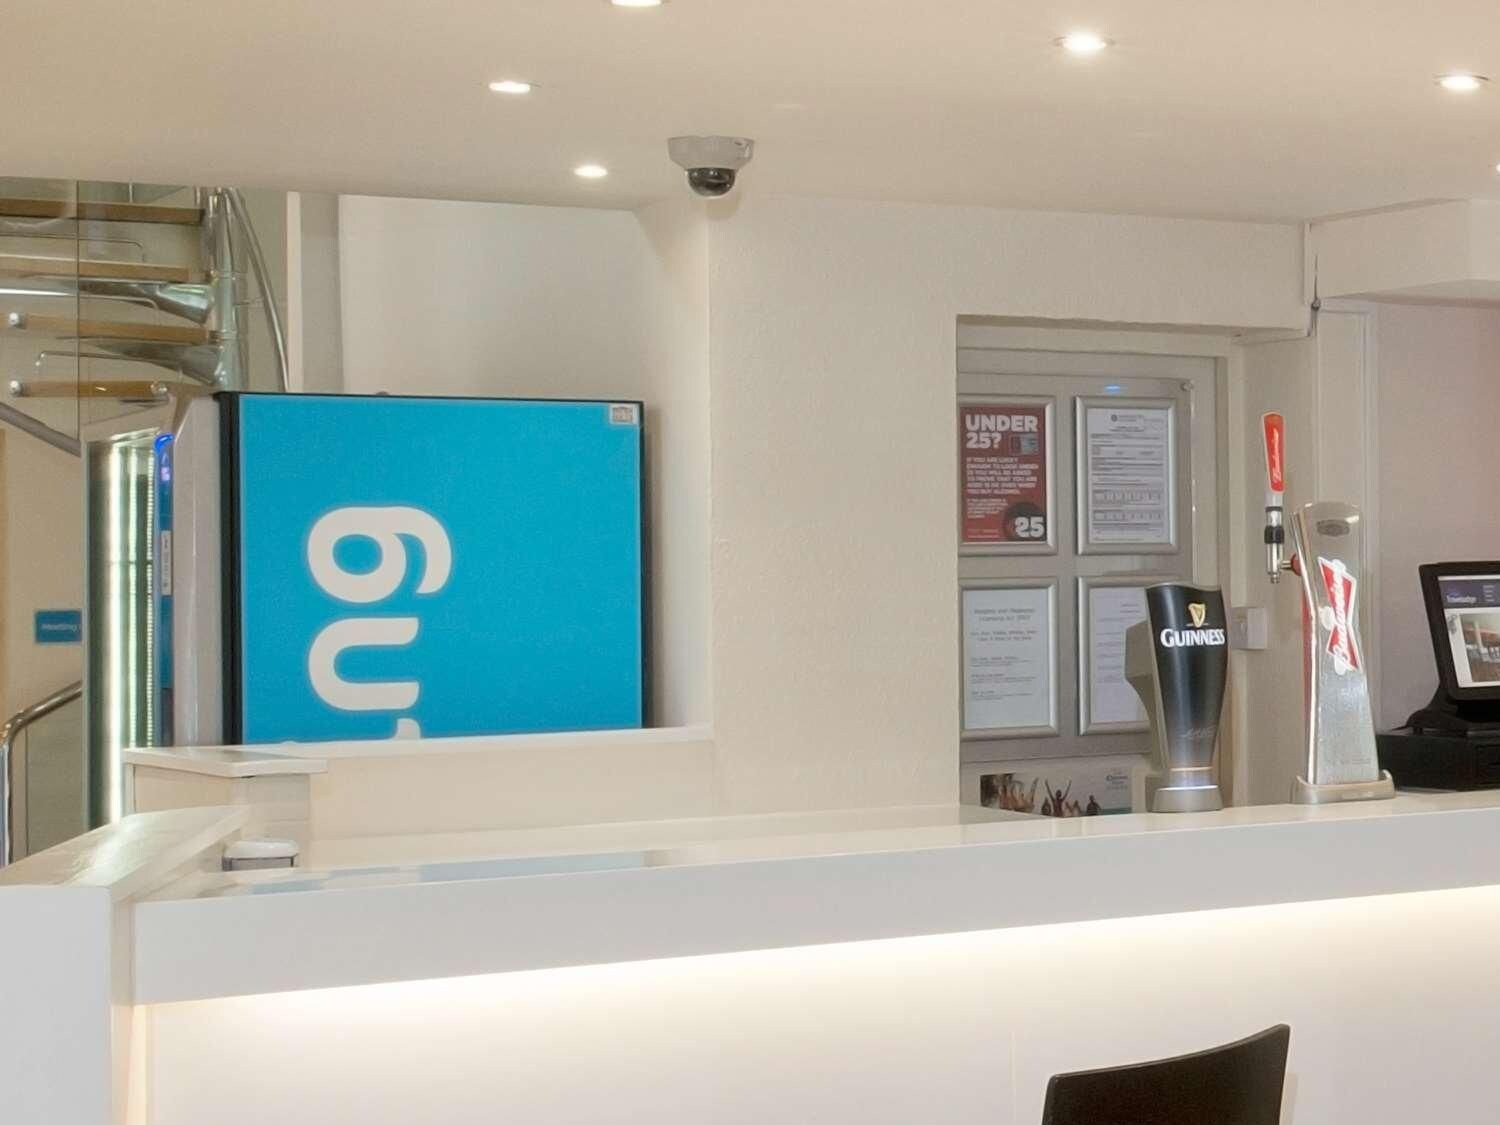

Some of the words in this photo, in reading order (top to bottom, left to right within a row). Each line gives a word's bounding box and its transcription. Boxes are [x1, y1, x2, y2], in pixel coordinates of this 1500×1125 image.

[965, 414, 1038, 432] UNDER
[965, 432, 1002, 449] 25?
[1014, 516, 1045, 538] 25
[1160, 628, 1225, 648] GUINNESS
